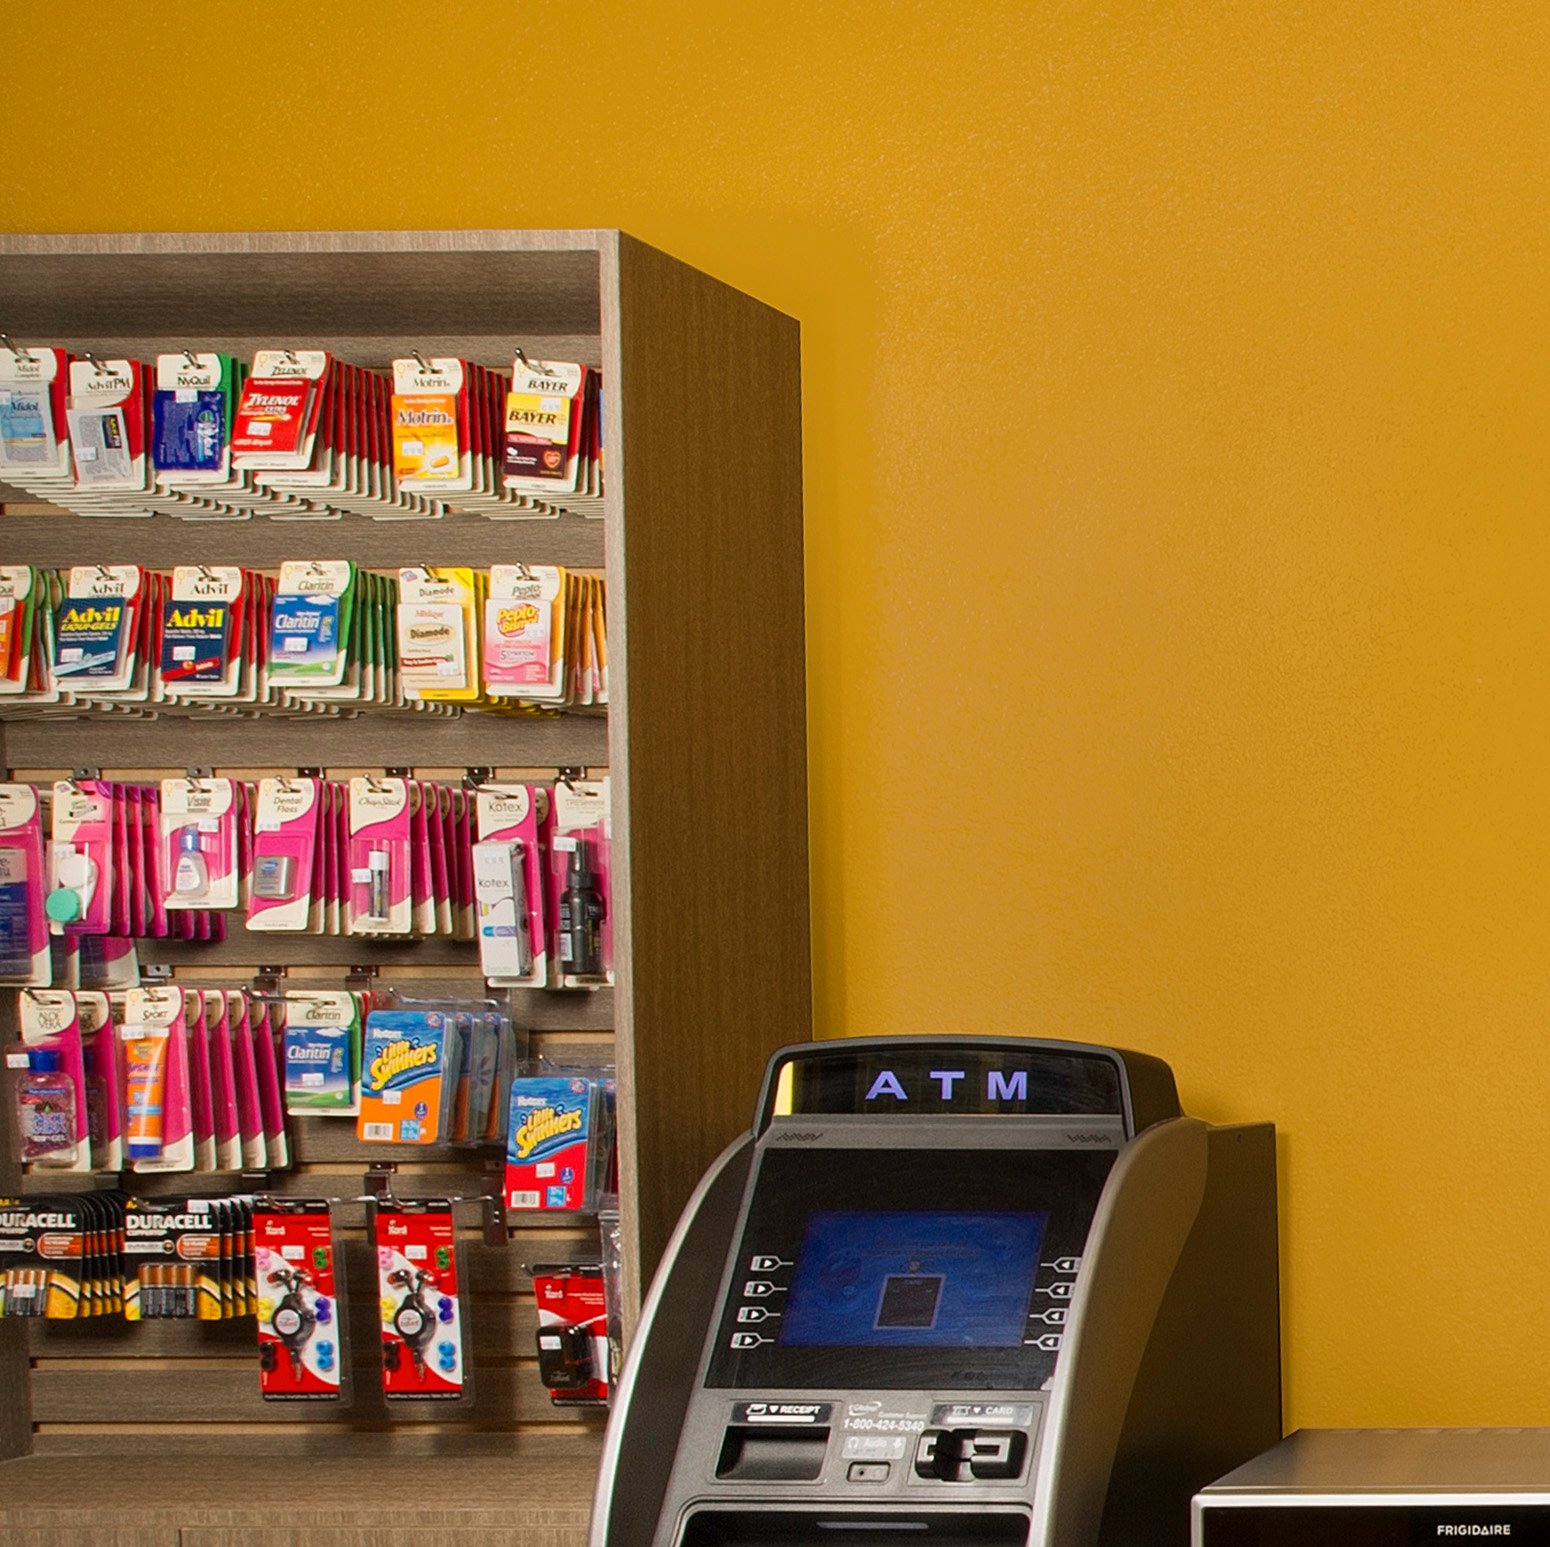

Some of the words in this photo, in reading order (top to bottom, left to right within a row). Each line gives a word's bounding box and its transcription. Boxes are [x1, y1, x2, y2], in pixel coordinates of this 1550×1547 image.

[177, 375, 211, 386] NyQuil
[528, 379, 569, 392] BAYER
[247, 392, 301, 407] TYLENOL
[398, 408, 447, 425] Motrin
[509, 410, 557, 425] BAYER
[191, 584, 230, 595] Advil
[63, 606, 121, 624] Advil
[166, 608, 224, 628] Advil
[274, 612, 320, 630] Claritin
[410, 626, 451, 640] Diamode
[288, 1045, 330, 1060] Claritin
[864, 1070, 1029, 1100] ATM
[126, 1215, 213, 1230] DURACELL
[780, 1404, 821, 1415] RECEIPT
[1437, 1524, 1511, 1536] FRIGIDAIRE
